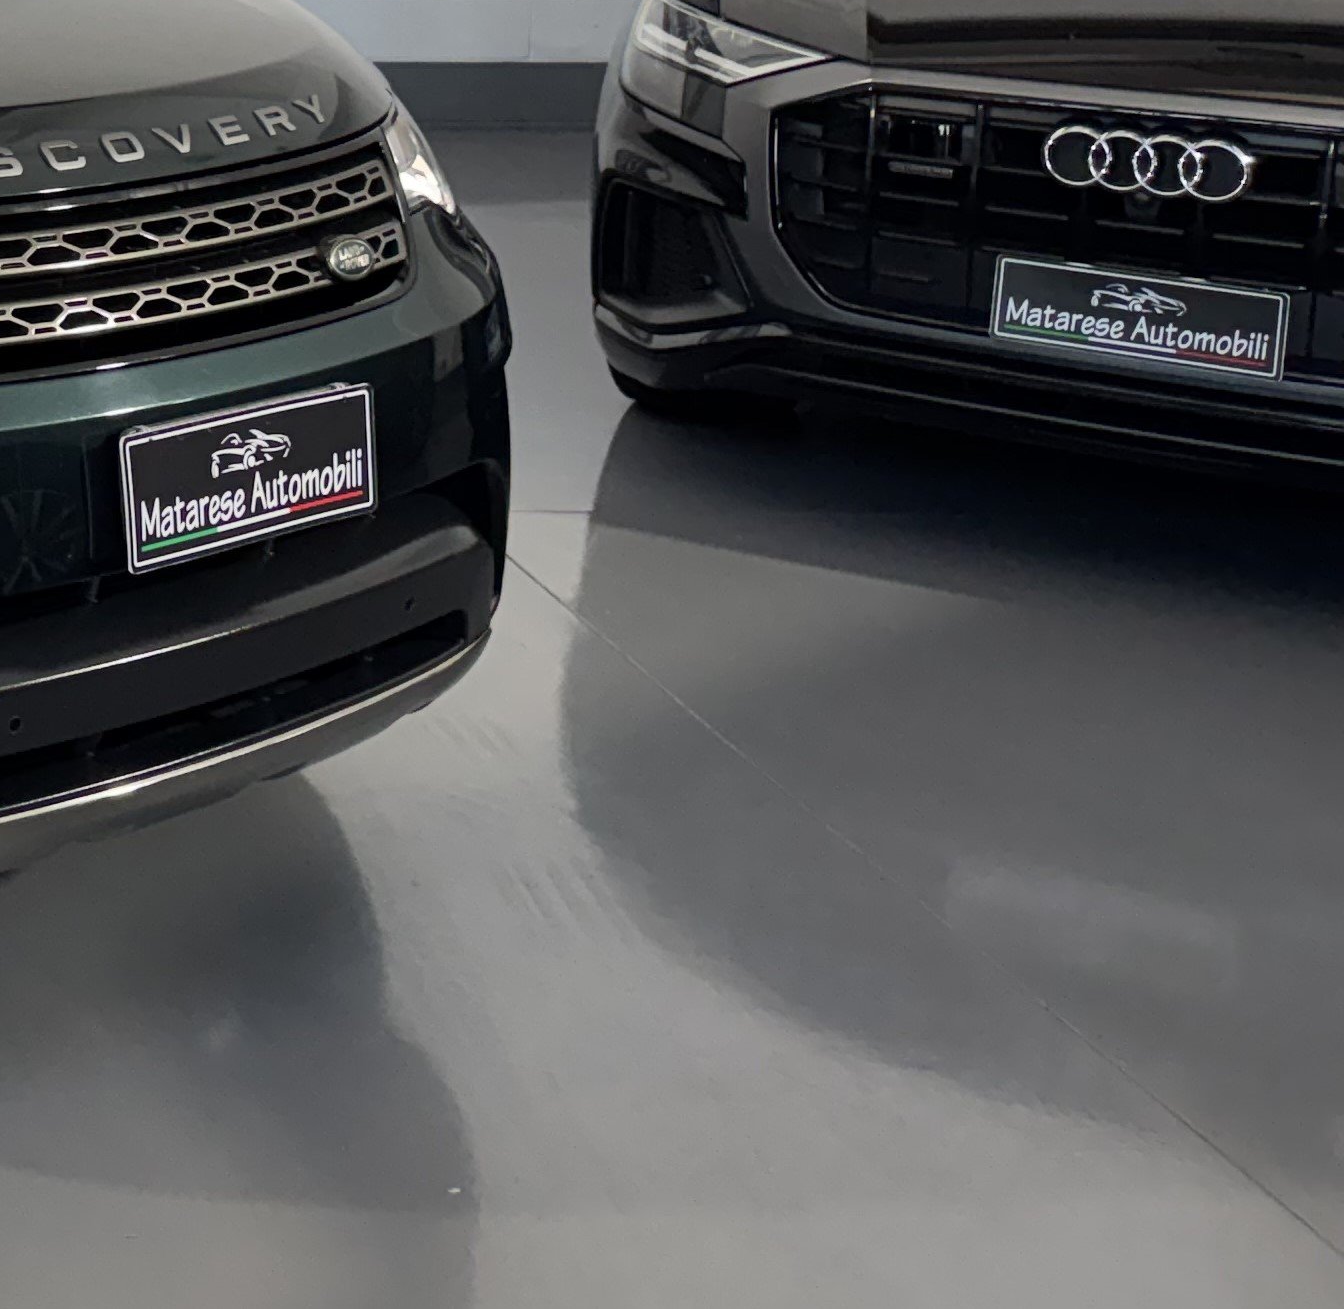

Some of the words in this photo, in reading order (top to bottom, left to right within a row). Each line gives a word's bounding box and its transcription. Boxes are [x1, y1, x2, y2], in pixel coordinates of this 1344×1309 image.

[1005, 296, 1125, 340] Matarese
[1129, 315, 1271, 361] Automobili
[140, 487, 247, 542] Matarese
[250, 447, 363, 514] Automobili
